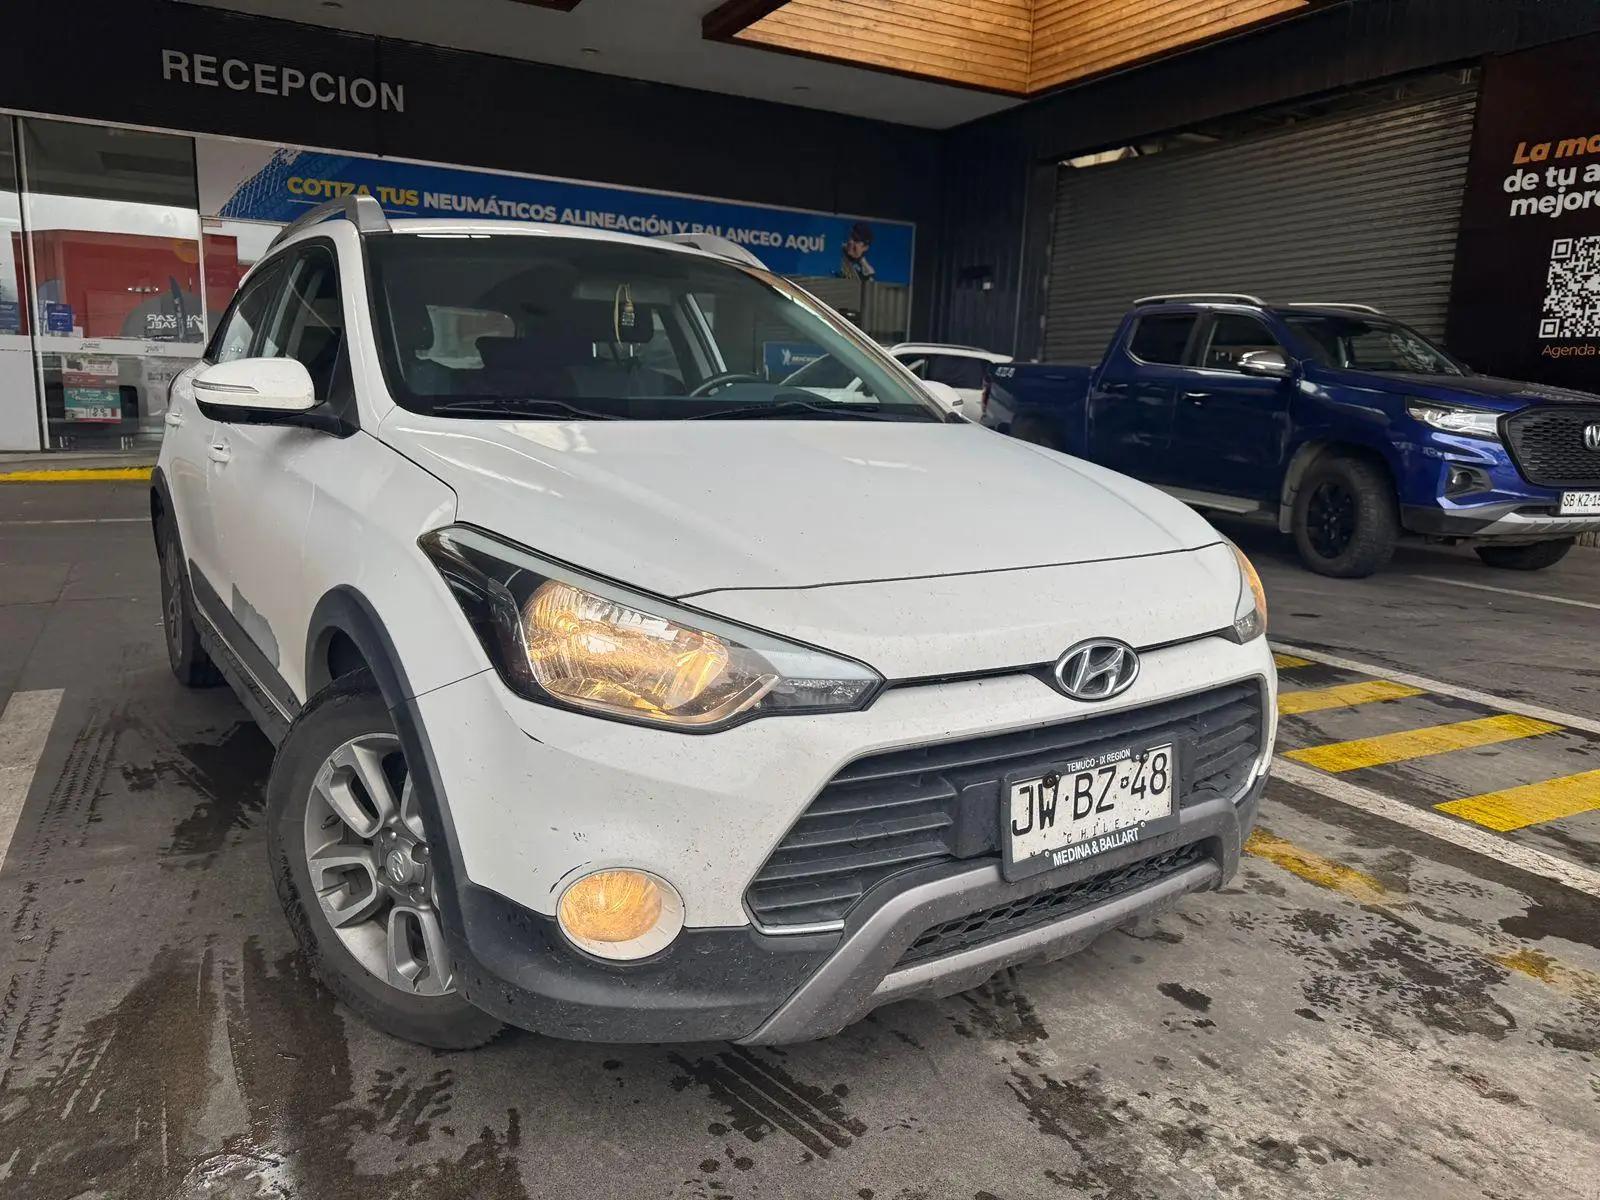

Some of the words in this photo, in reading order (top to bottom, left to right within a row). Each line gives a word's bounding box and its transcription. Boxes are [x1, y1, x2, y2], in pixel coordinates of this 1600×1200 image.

[162, 49, 404, 112] RECEPCION
[1512, 141, 1551, 164] La
[1503, 168, 1539, 193] de
[1545, 166, 1577, 188] tu
[287, 177, 370, 199] COTIZA
[376, 186, 420, 206] TUS
[423, 191, 557, 222] NEUMÁTICOS
[560, 208, 672, 234] ALINEACIÓN
[676, 221, 689, 234] Y
[785, 234, 825, 253] AQUÍ
[1541, 343, 1596, 358] Agenda
[1067, 757, 1095, 773] TEMUCO
[1106, 748, 1131, 763] REGION
[1066, 818, 1120, 844] CHILE
[1053, 842, 1090, 867] MEDINA
[1091, 841, 1099, 854] &
[1099, 827, 1139, 852] BALLART
